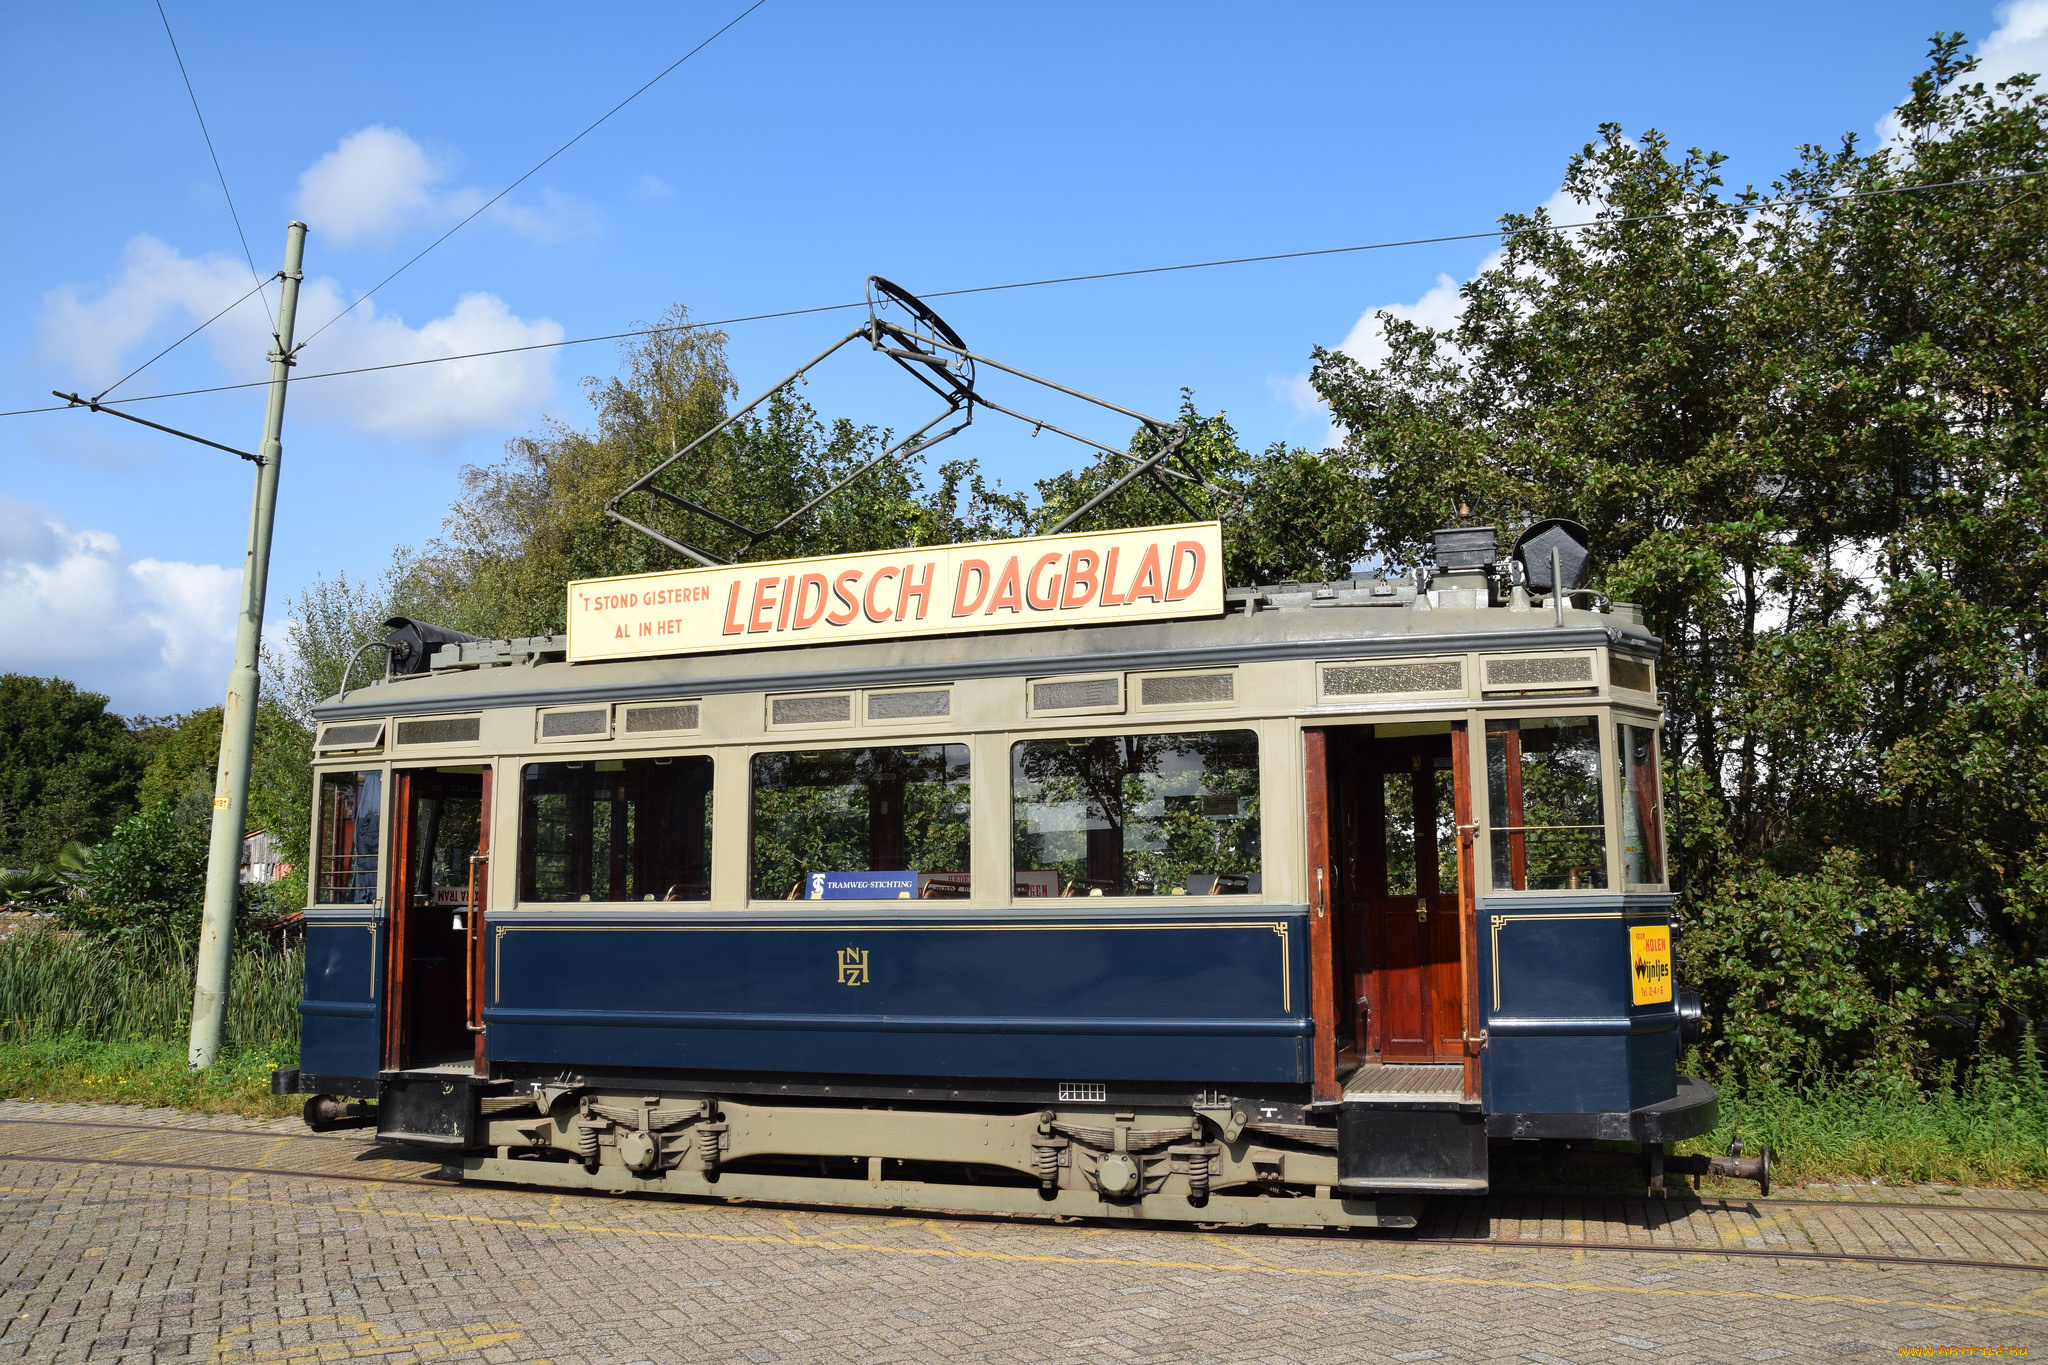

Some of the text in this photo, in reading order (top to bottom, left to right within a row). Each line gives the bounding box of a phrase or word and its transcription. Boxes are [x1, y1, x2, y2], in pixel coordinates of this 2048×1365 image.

[594, 592, 638, 611] STOND
[643, 585, 710, 606] GISTEREN
[723, 540, 1207, 636] LEIDSCH DAGBLAD
[615, 618, 683, 639] AL IN HET
[827, 880, 913, 889] TRAMWEG-STICHTING
[1645, 938, 1666, 952] KOLEN
